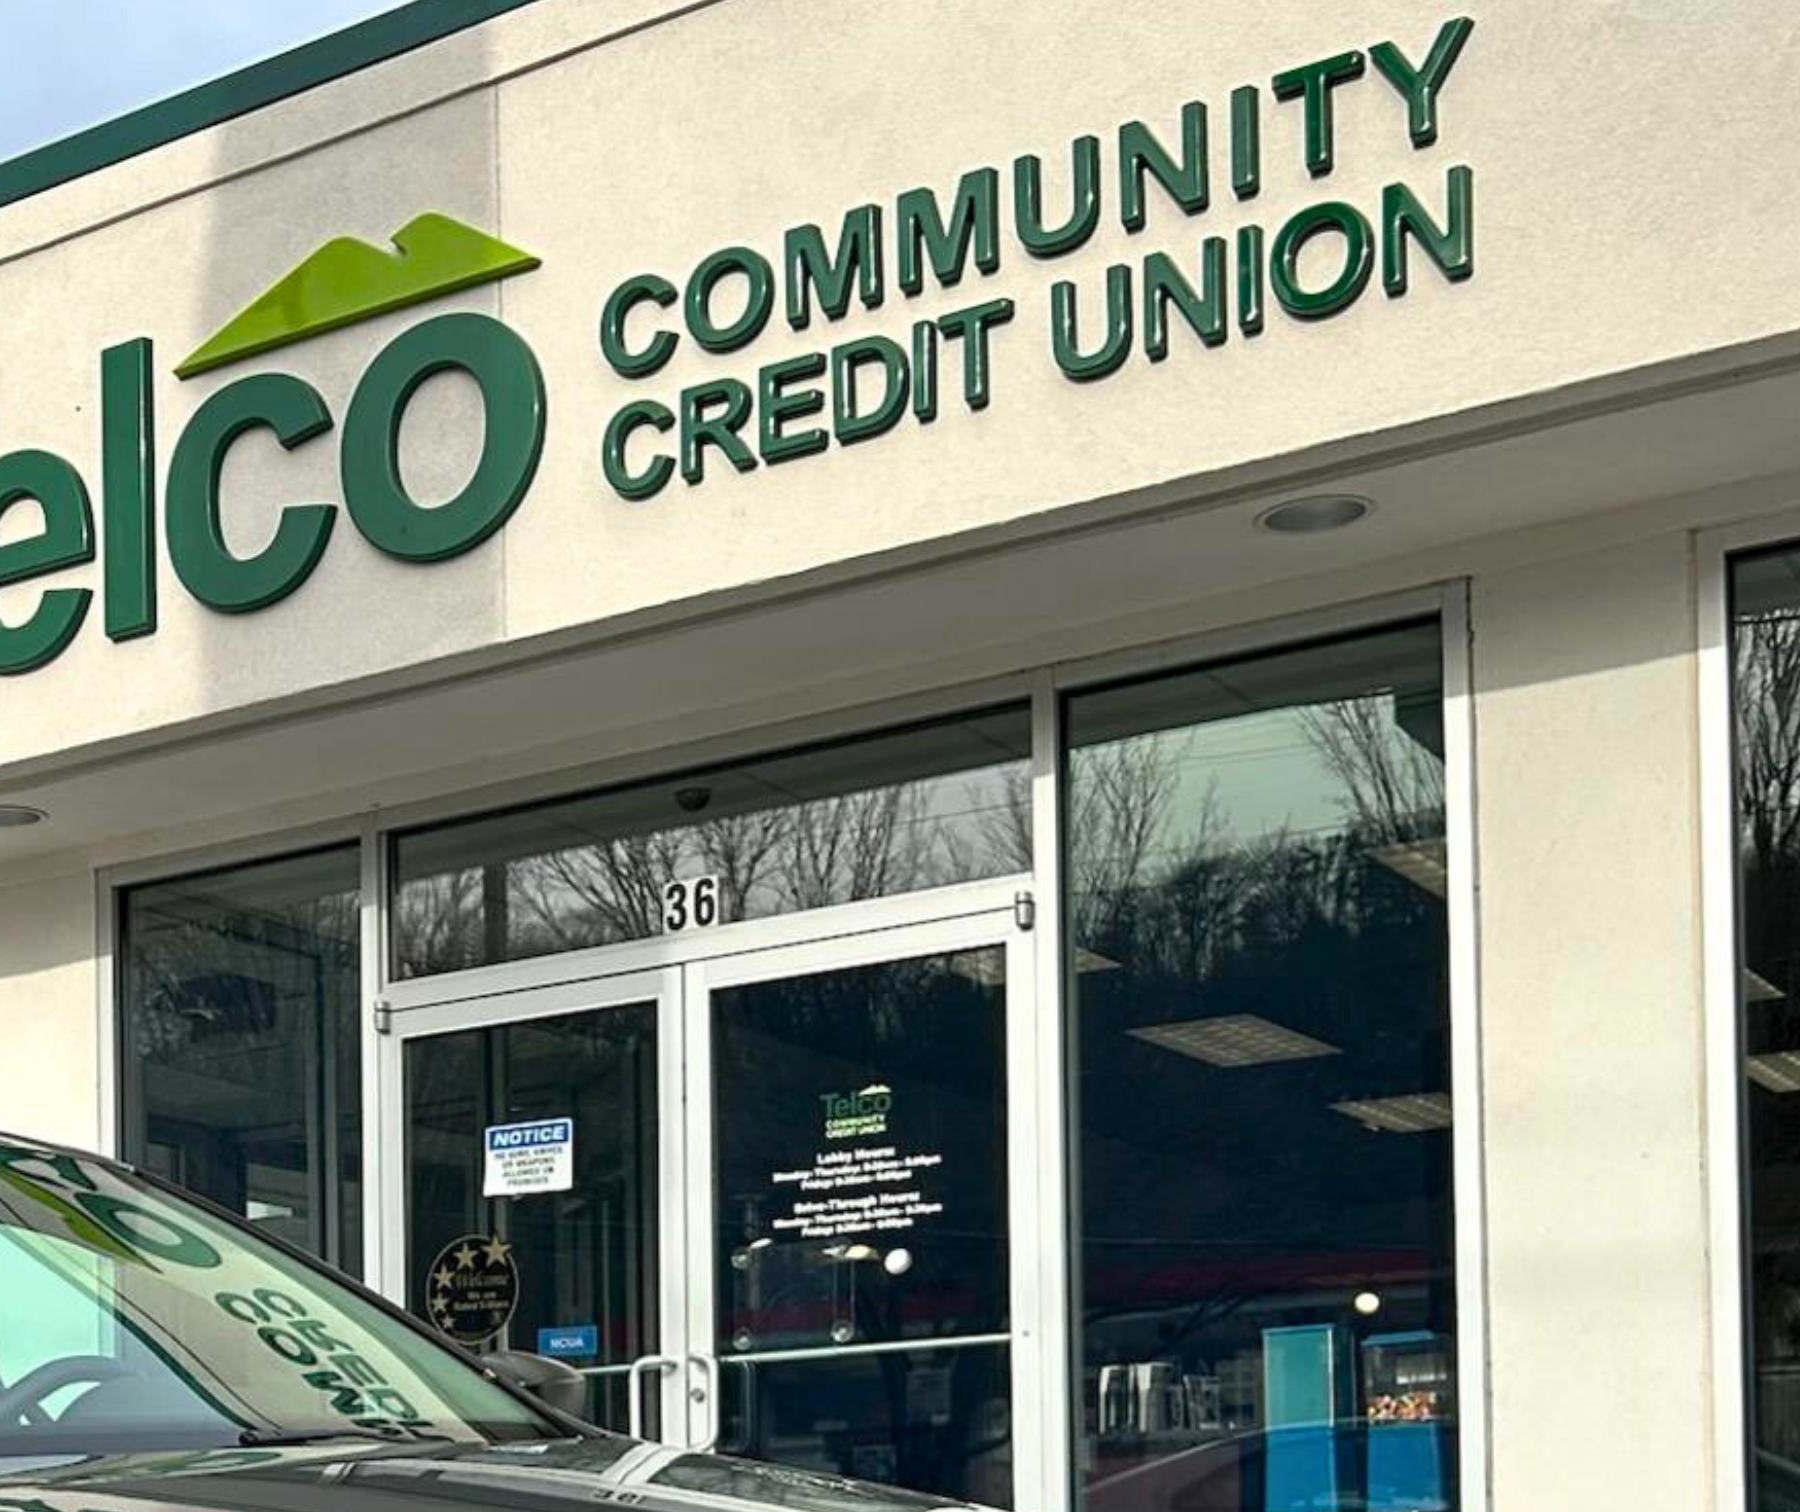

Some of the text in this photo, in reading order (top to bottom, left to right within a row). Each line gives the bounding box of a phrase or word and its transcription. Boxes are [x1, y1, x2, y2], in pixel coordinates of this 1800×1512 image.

[600, 17, 1474, 379] COMMUNITY
[601, 165, 1474, 501] CREDIT UNION
[666, 878, 715, 931] 36
[818, 1090, 892, 1118] Telco
[493, 1125, 565, 1147] NOTICE
